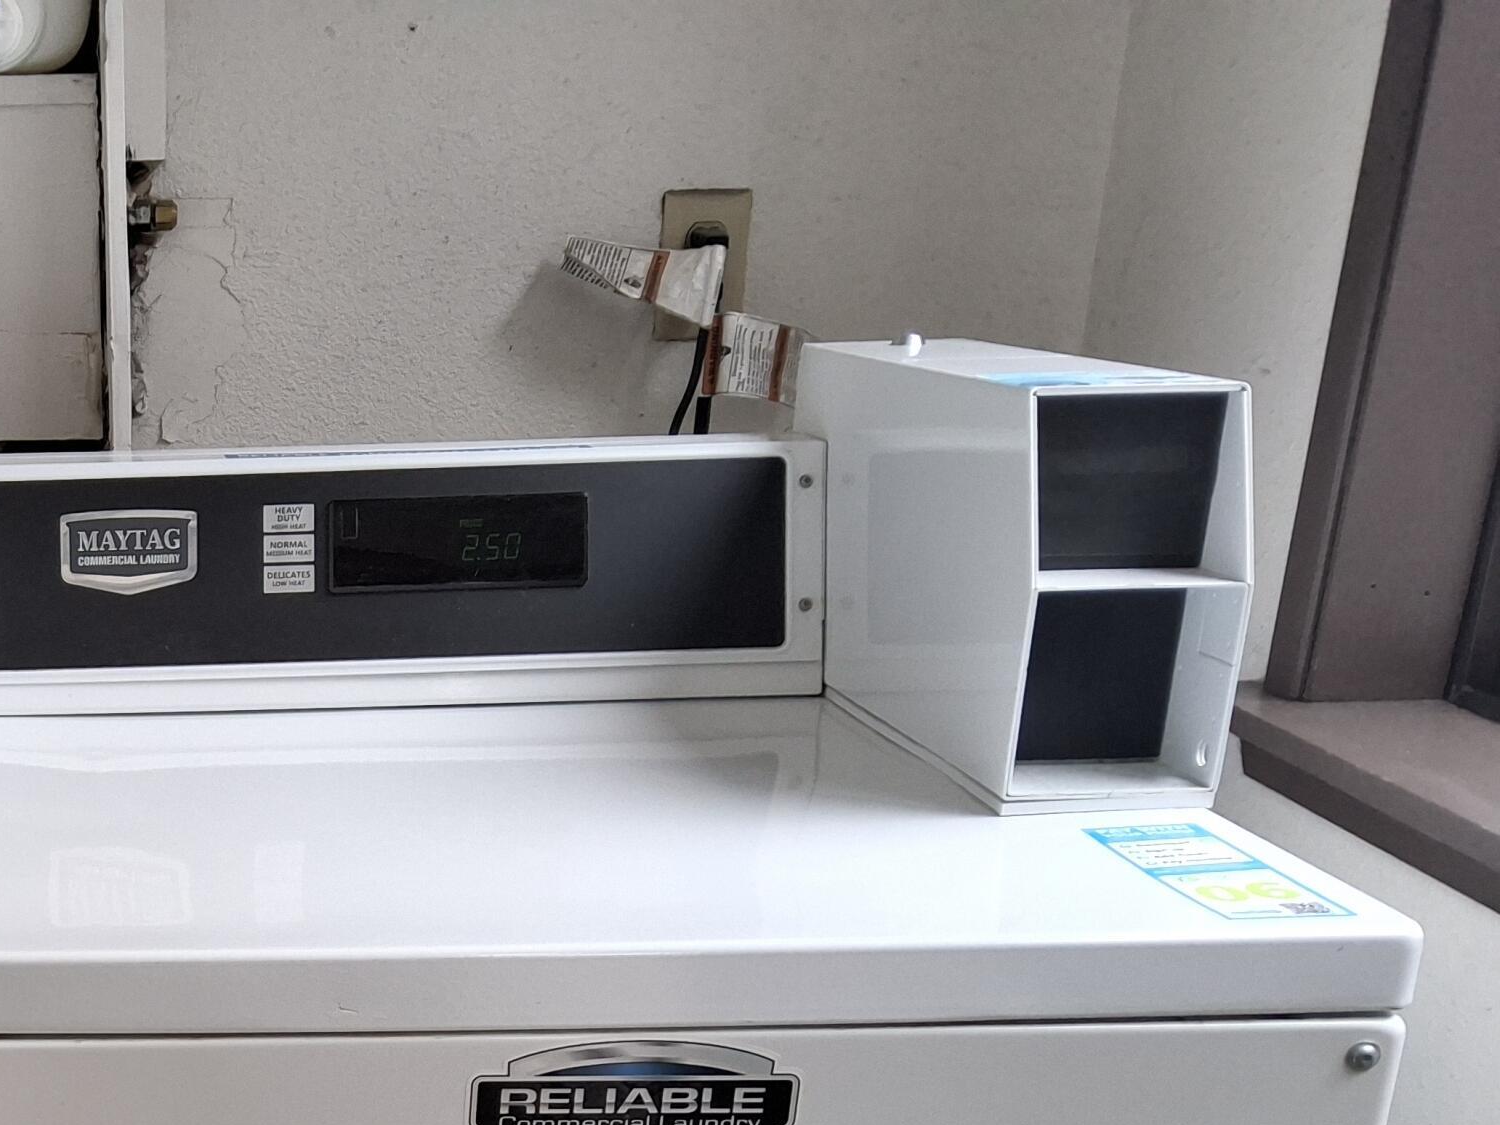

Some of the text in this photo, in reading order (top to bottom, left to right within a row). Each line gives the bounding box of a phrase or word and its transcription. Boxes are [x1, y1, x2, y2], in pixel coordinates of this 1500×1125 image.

[274, 506, 303, 515] HEAVY
[277, 514, 300, 523] DUTY
[77, 528, 181, 551] MAYTAG
[270, 541, 308, 549] NORMAL
[462, 532, 521, 560] 2.50
[78, 554, 180, 566] COMMERCIAL LAUNDRY
[267, 570, 311, 580] DELICATES
[1196, 882, 1300, 902] 06
[500, 1087, 767, 1114] RELIABLE
